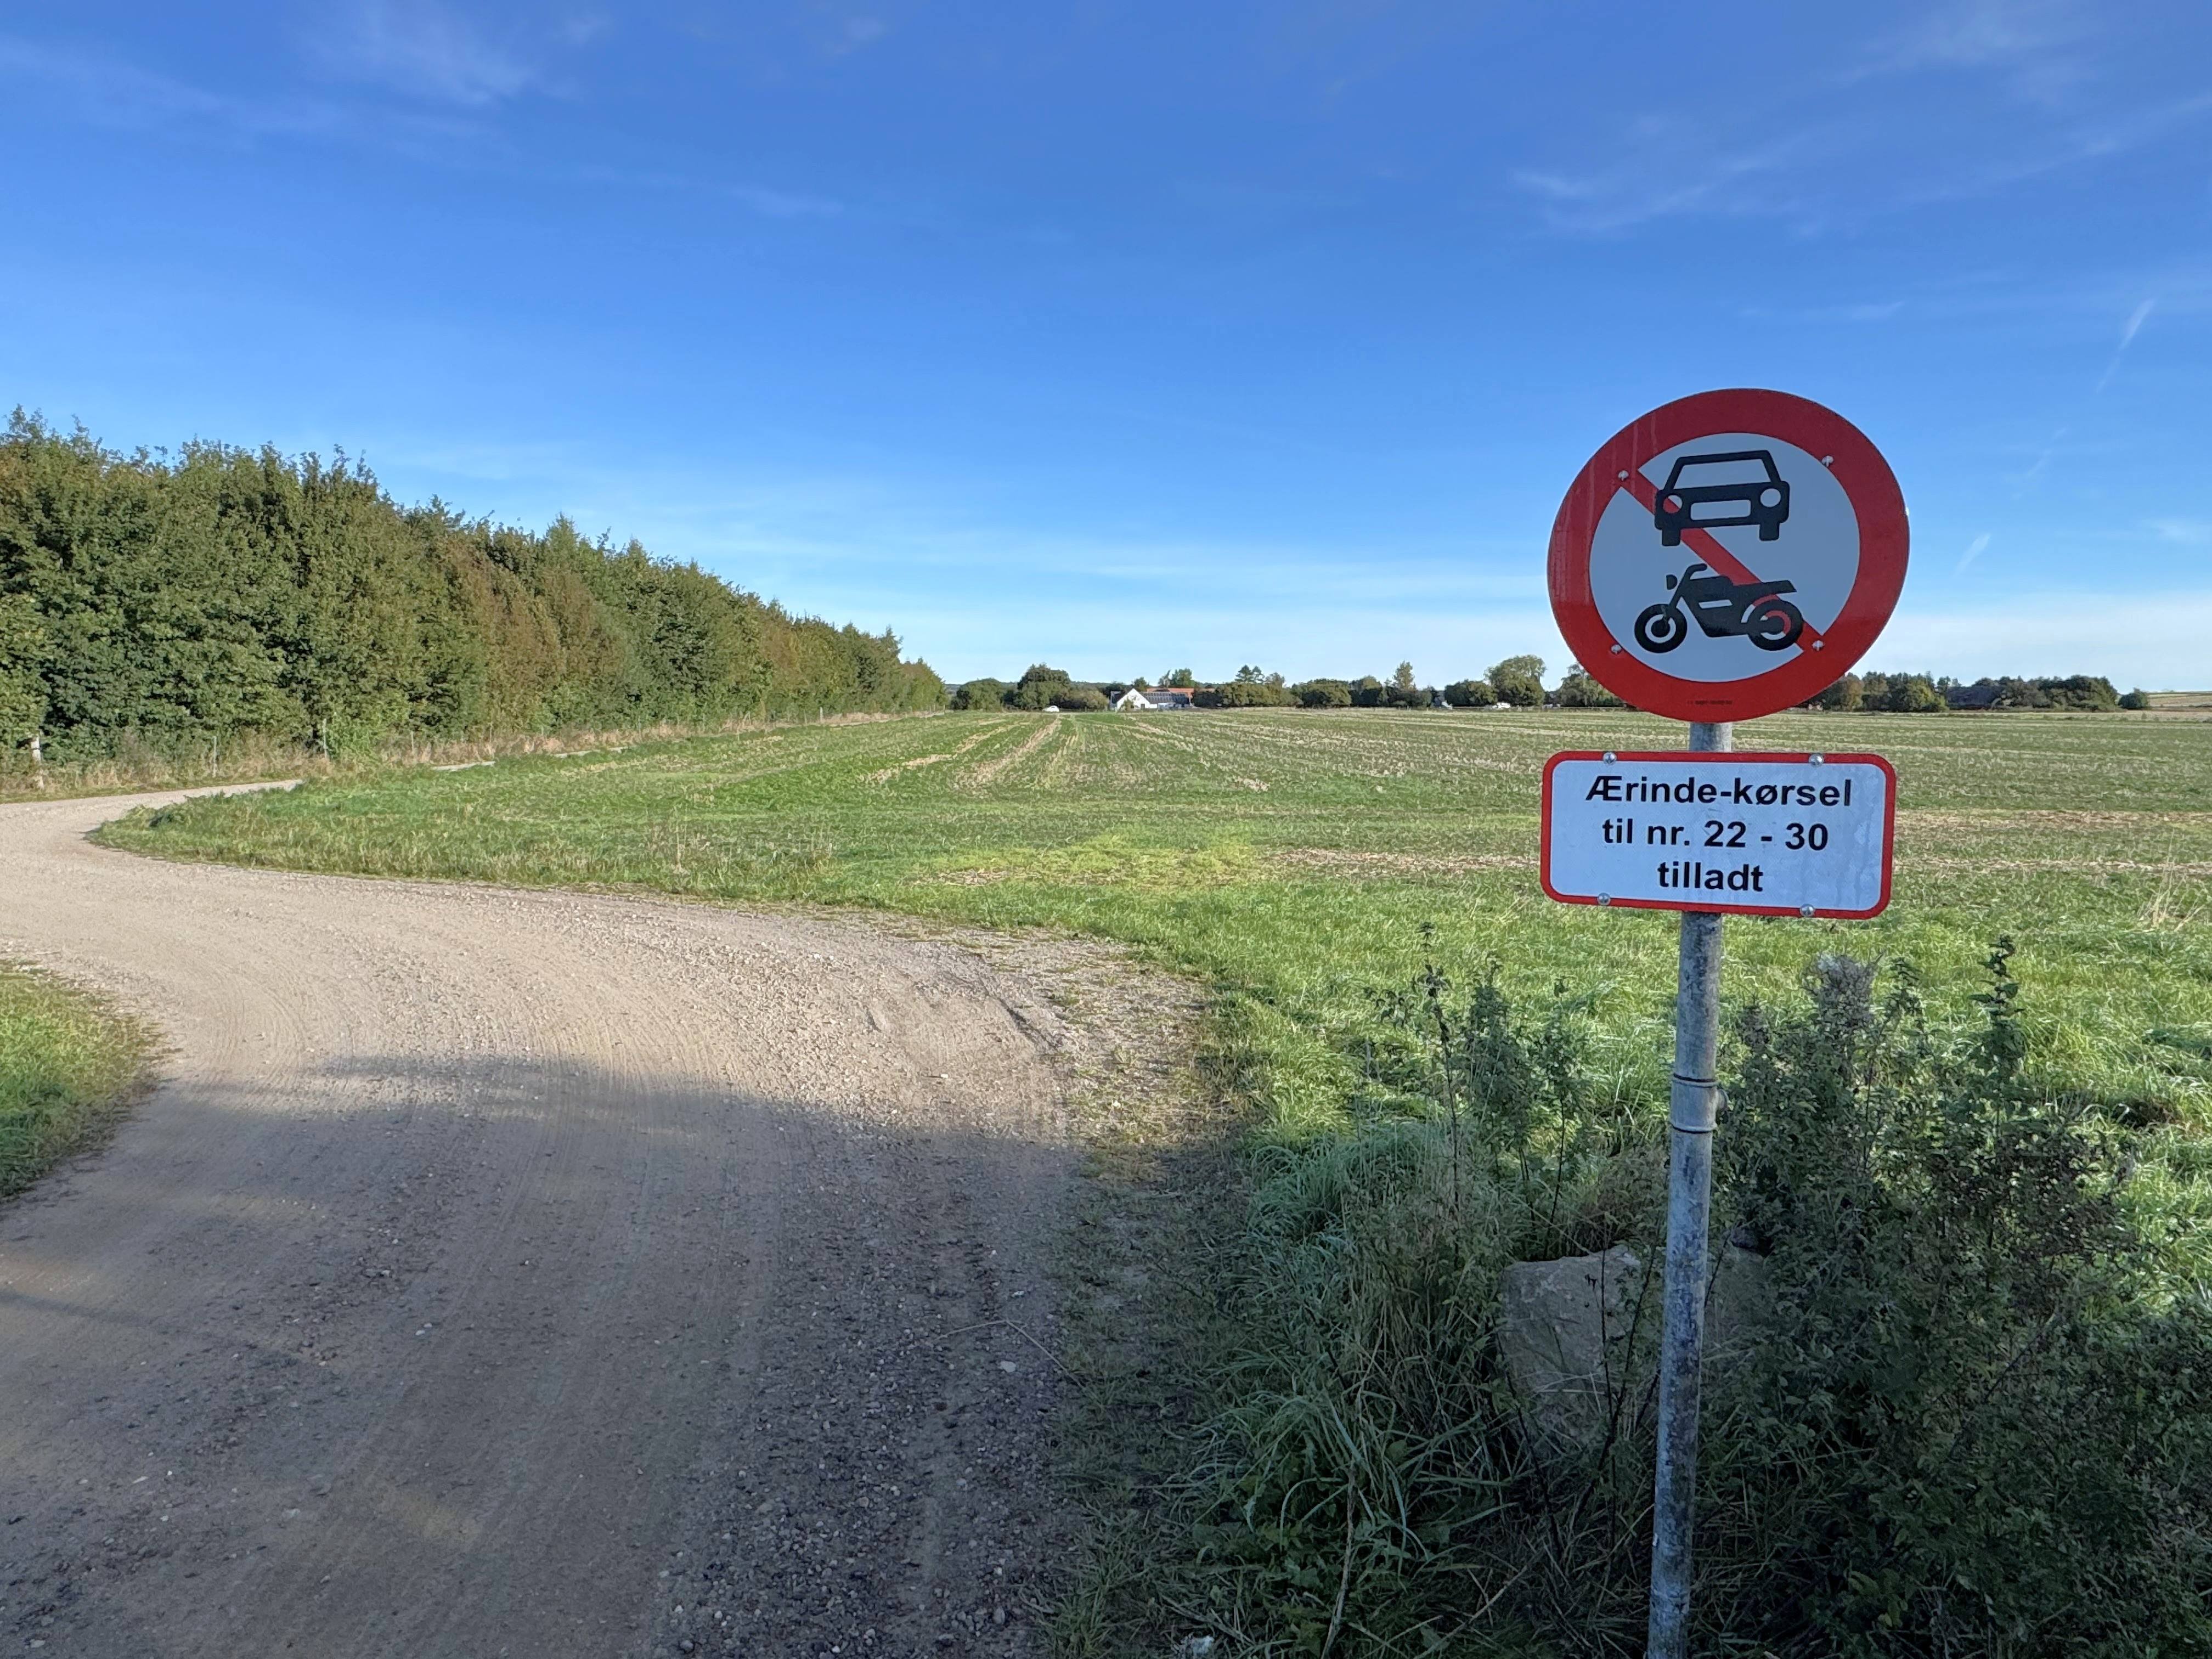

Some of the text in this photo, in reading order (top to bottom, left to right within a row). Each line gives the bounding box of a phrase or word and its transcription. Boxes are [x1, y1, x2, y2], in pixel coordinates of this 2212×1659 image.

[1585, 776, 1852, 806] Ærinde-kørsel
[1602, 818, 1633, 844] til
[1647, 826, 1690, 846] nr.
[1704, 820, 1746, 848] 22
[1785, 823, 1828, 851] 30
[1657, 861, 1763, 892] tilladt
